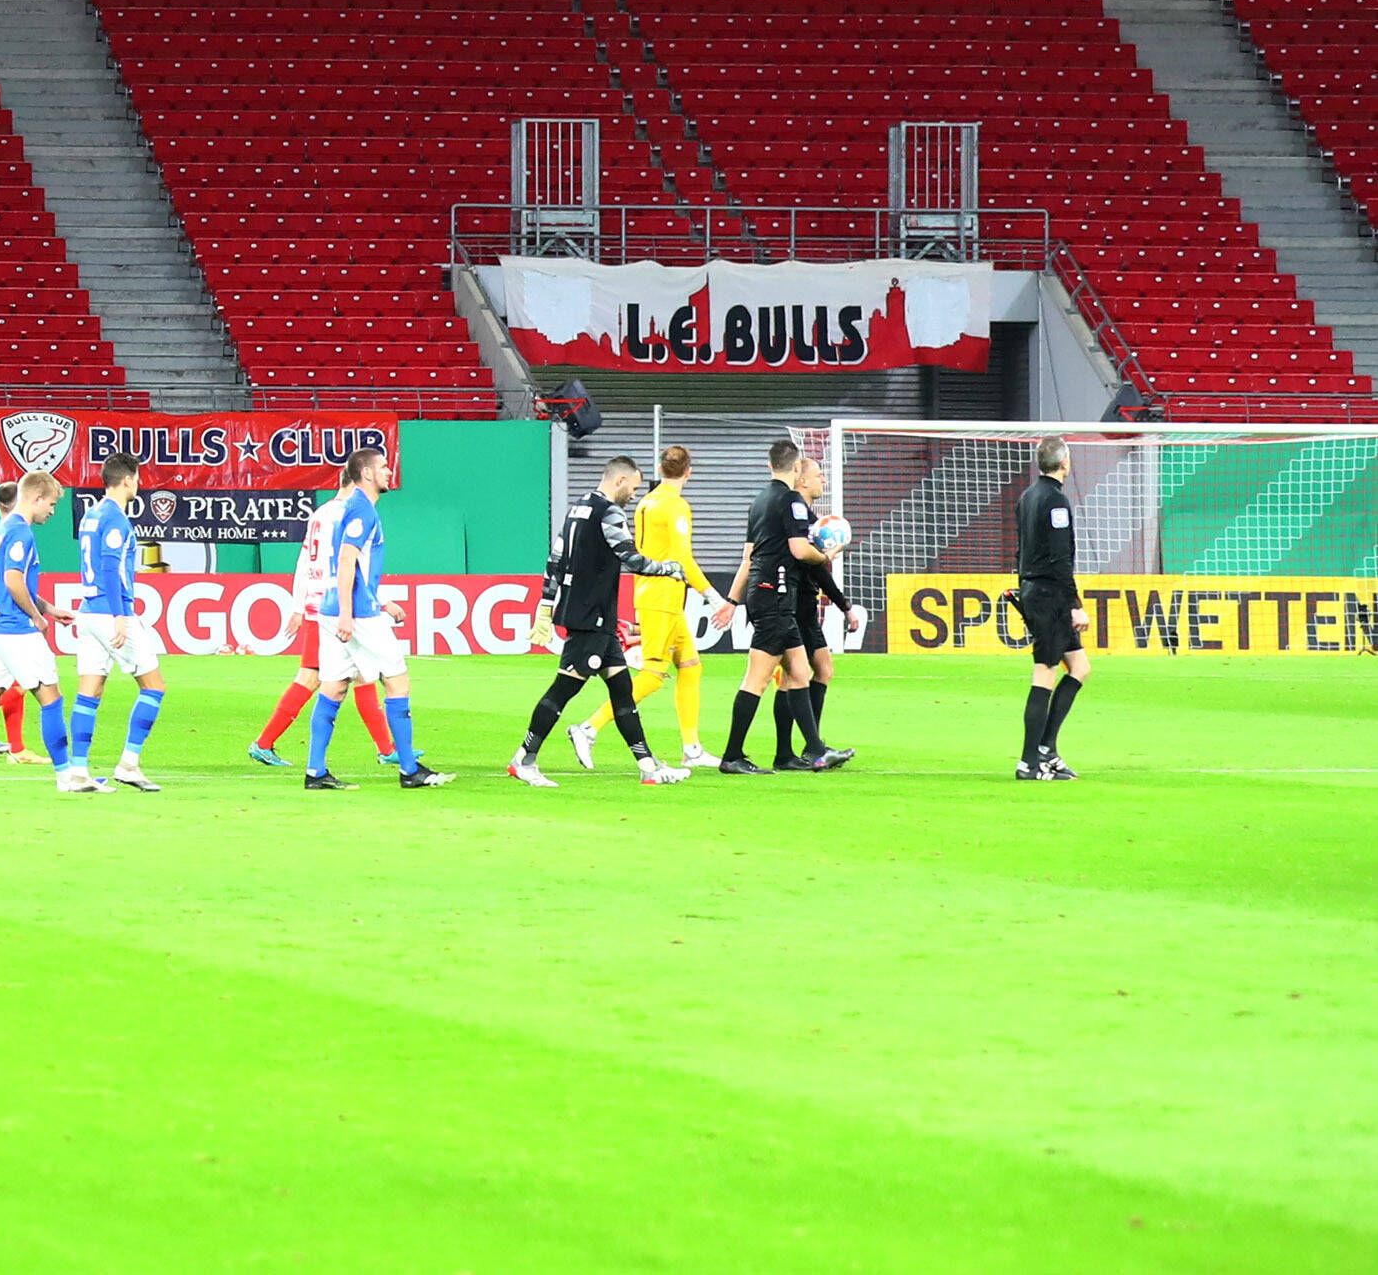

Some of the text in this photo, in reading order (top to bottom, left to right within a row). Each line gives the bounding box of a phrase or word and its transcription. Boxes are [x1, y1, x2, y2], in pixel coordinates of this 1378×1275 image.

[626, 303, 869, 367] L.E. BULLS
[5, 415, 72, 430] BULLS CLUB
[87, 425, 389, 468] BULLS CLUB
[172, 527, 212, 541] FROM
[217, 527, 258, 540] HOME
